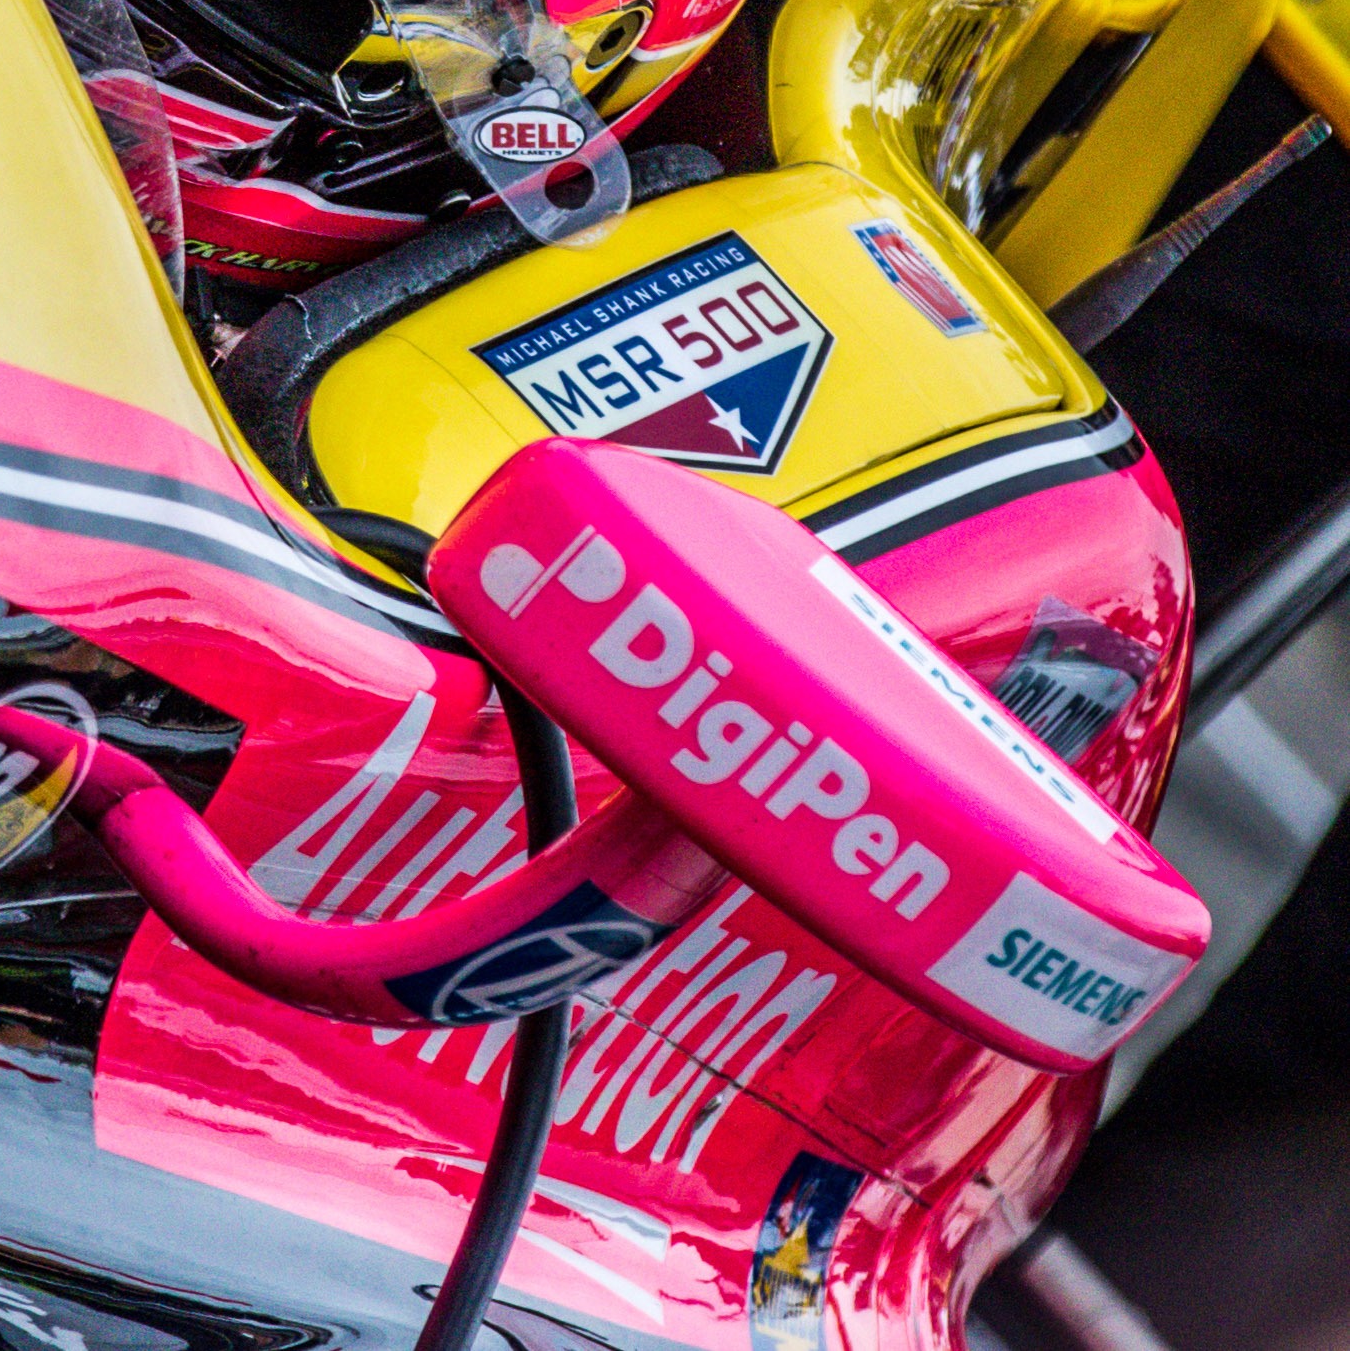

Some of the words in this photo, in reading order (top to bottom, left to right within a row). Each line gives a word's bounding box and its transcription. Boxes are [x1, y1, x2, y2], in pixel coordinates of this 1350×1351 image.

[491, 122, 577, 149] BELL
[502, 149, 563, 157] HELMETS
[495, 316, 593, 368] MICHAEL
[596, 284, 668, 325] SHANK
[669, 246, 748, 288] RACING
[530, 334, 684, 431] MSR
[662, 280, 802, 370] 500
[586, 582, 952, 923] DigiPen
[848, 589, 1077, 806] SIEMENS
[986, 927, 1147, 1027] SIEMENS
